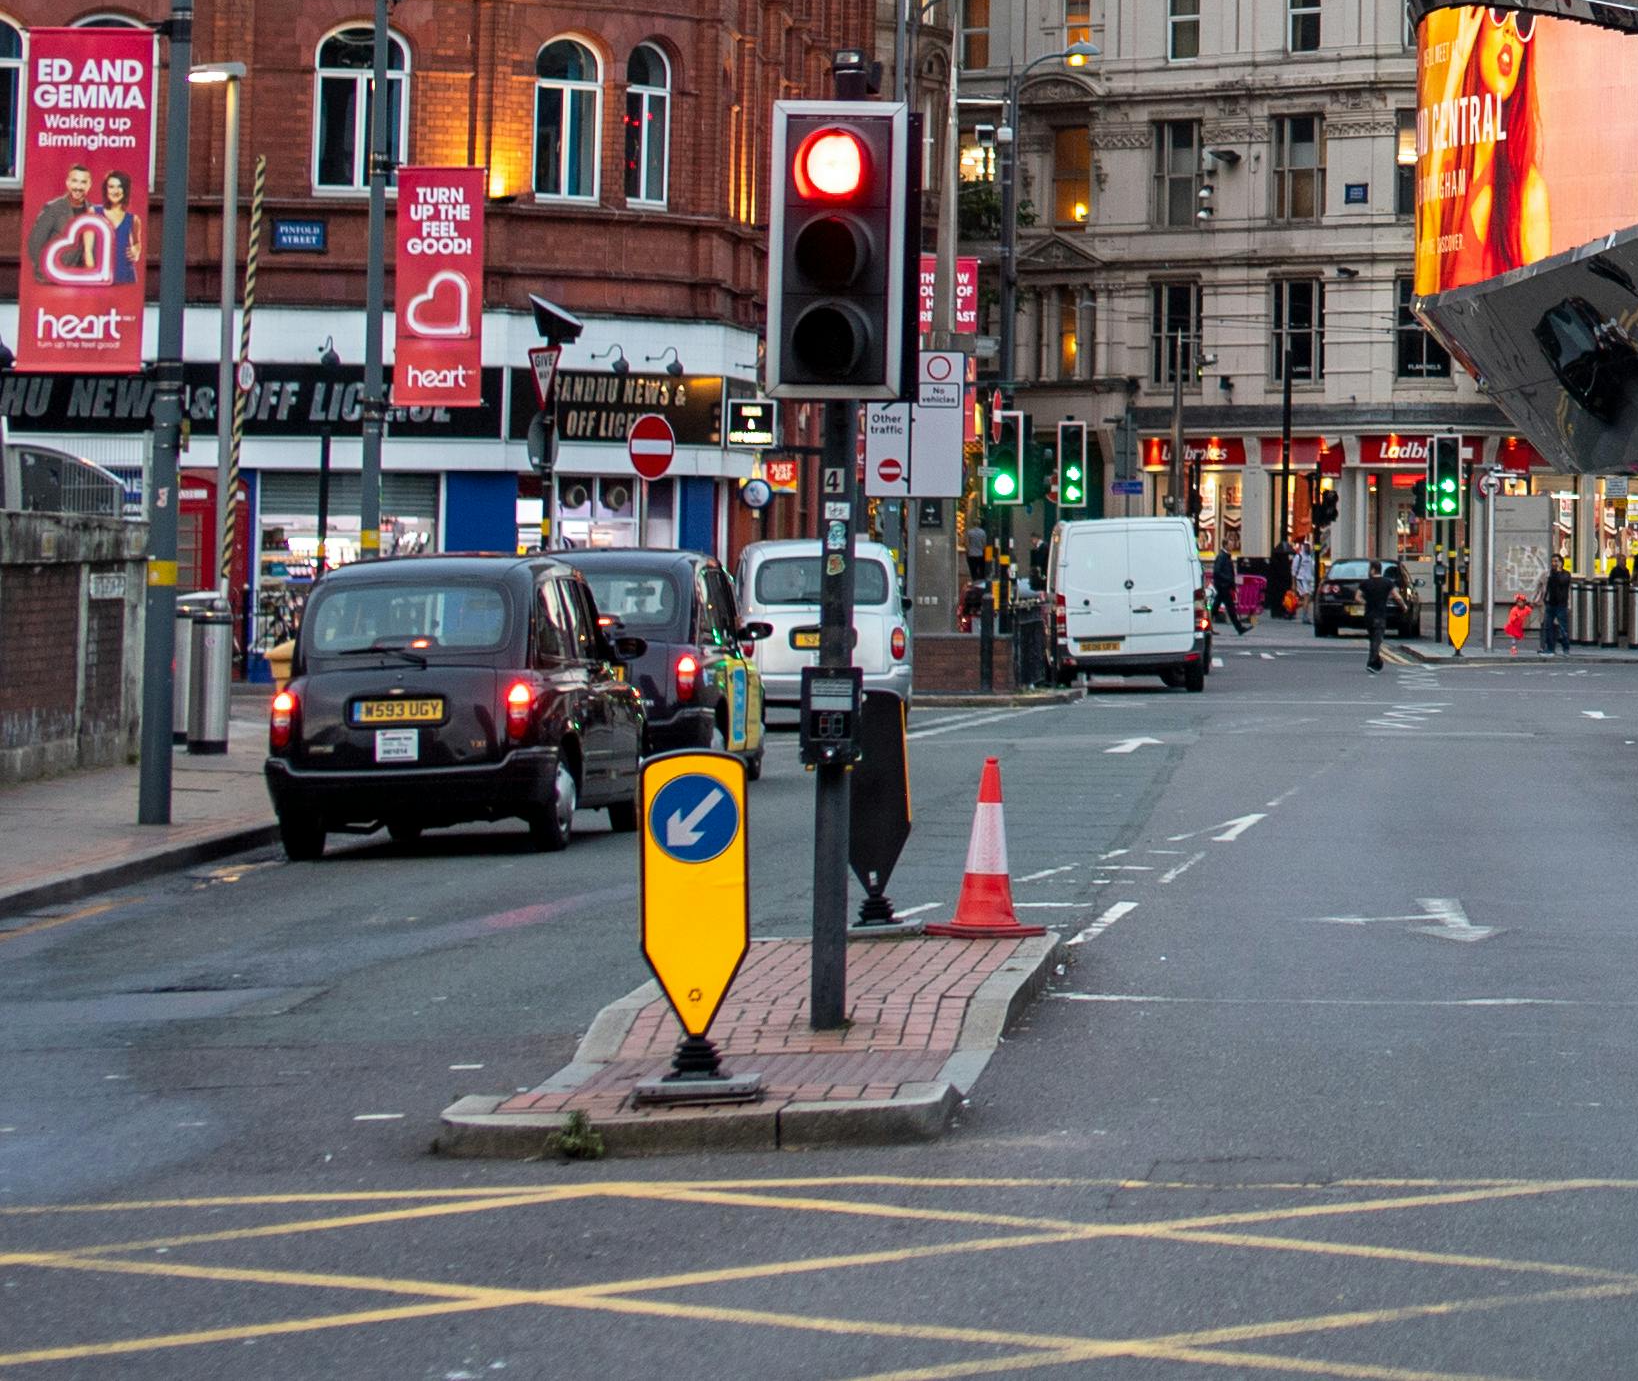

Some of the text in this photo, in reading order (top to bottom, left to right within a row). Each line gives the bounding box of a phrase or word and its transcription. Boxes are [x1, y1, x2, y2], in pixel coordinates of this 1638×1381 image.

[37, 58, 144, 83] ED AND
[34, 84, 146, 109] GEMMA
[44, 114, 131, 132] Waking up
[1432, 92, 1507, 151] CENTRAL
[38, 132, 136, 151] Birmingham
[416, 187, 464, 204] TURN
[410, 204, 470, 221] UP THE
[422, 221, 458, 237] FEEL
[281, 236, 317, 244] STREET
[407, 238, 472, 255] GOOD!
[920, 273, 936, 283] TH
[957, 285, 973, 296] OF
[37, 308, 121, 339] heart
[534, 353, 554, 367] GIVE
[407, 364, 467, 388] heart
[67, 377, 157, 418] NEW
[190, 386, 217, 419] &
[554, 375, 687, 407] SANDHU NEWS &
[933, 387, 945, 395] No
[566, 409, 597, 437] OFF
[871, 414, 902, 425] Other
[870, 424, 903, 435] traffic
[1161, 444, 1228, 461] Lbrokes
[826, 470, 840, 491] 4
[409, 701, 440, 717] UGY
